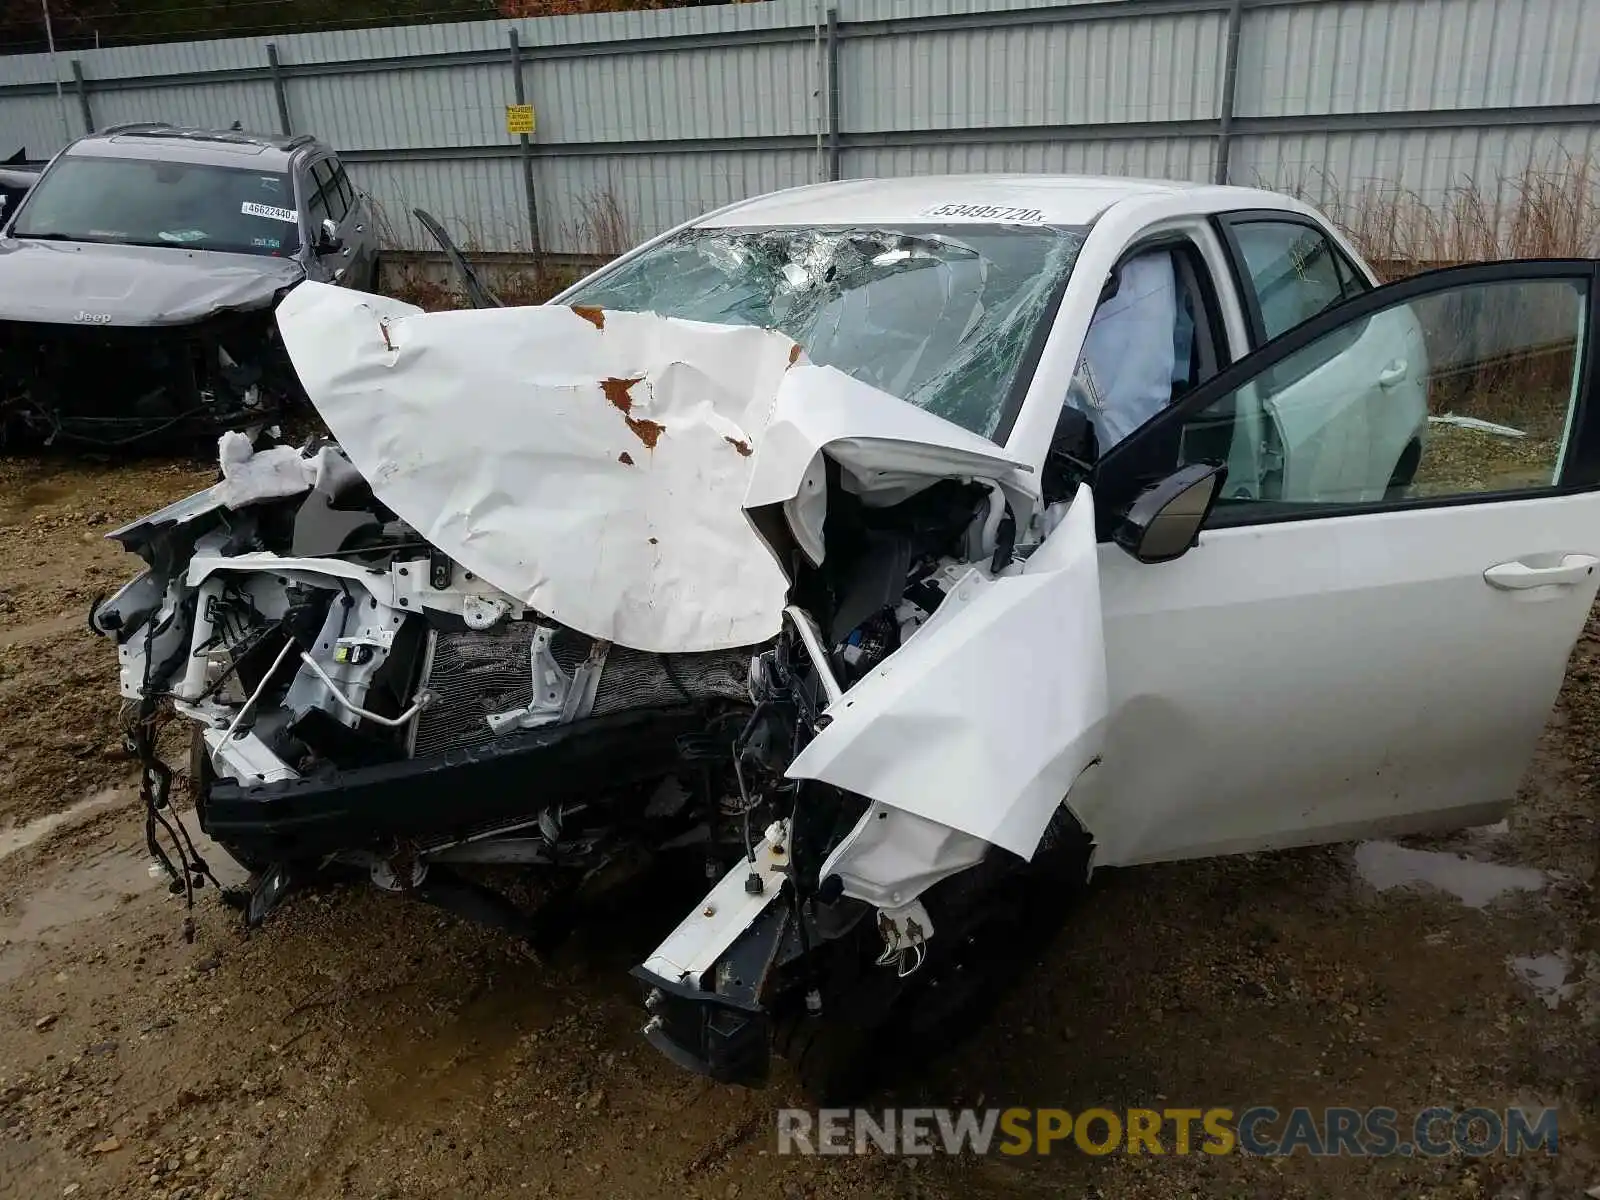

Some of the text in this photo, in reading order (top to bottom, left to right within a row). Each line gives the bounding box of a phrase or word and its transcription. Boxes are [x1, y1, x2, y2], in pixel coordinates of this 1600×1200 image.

[248, 204, 291, 219] 46622440
[934, 203, 1041, 221] 53495720
[73, 310, 112, 324] Jeep
